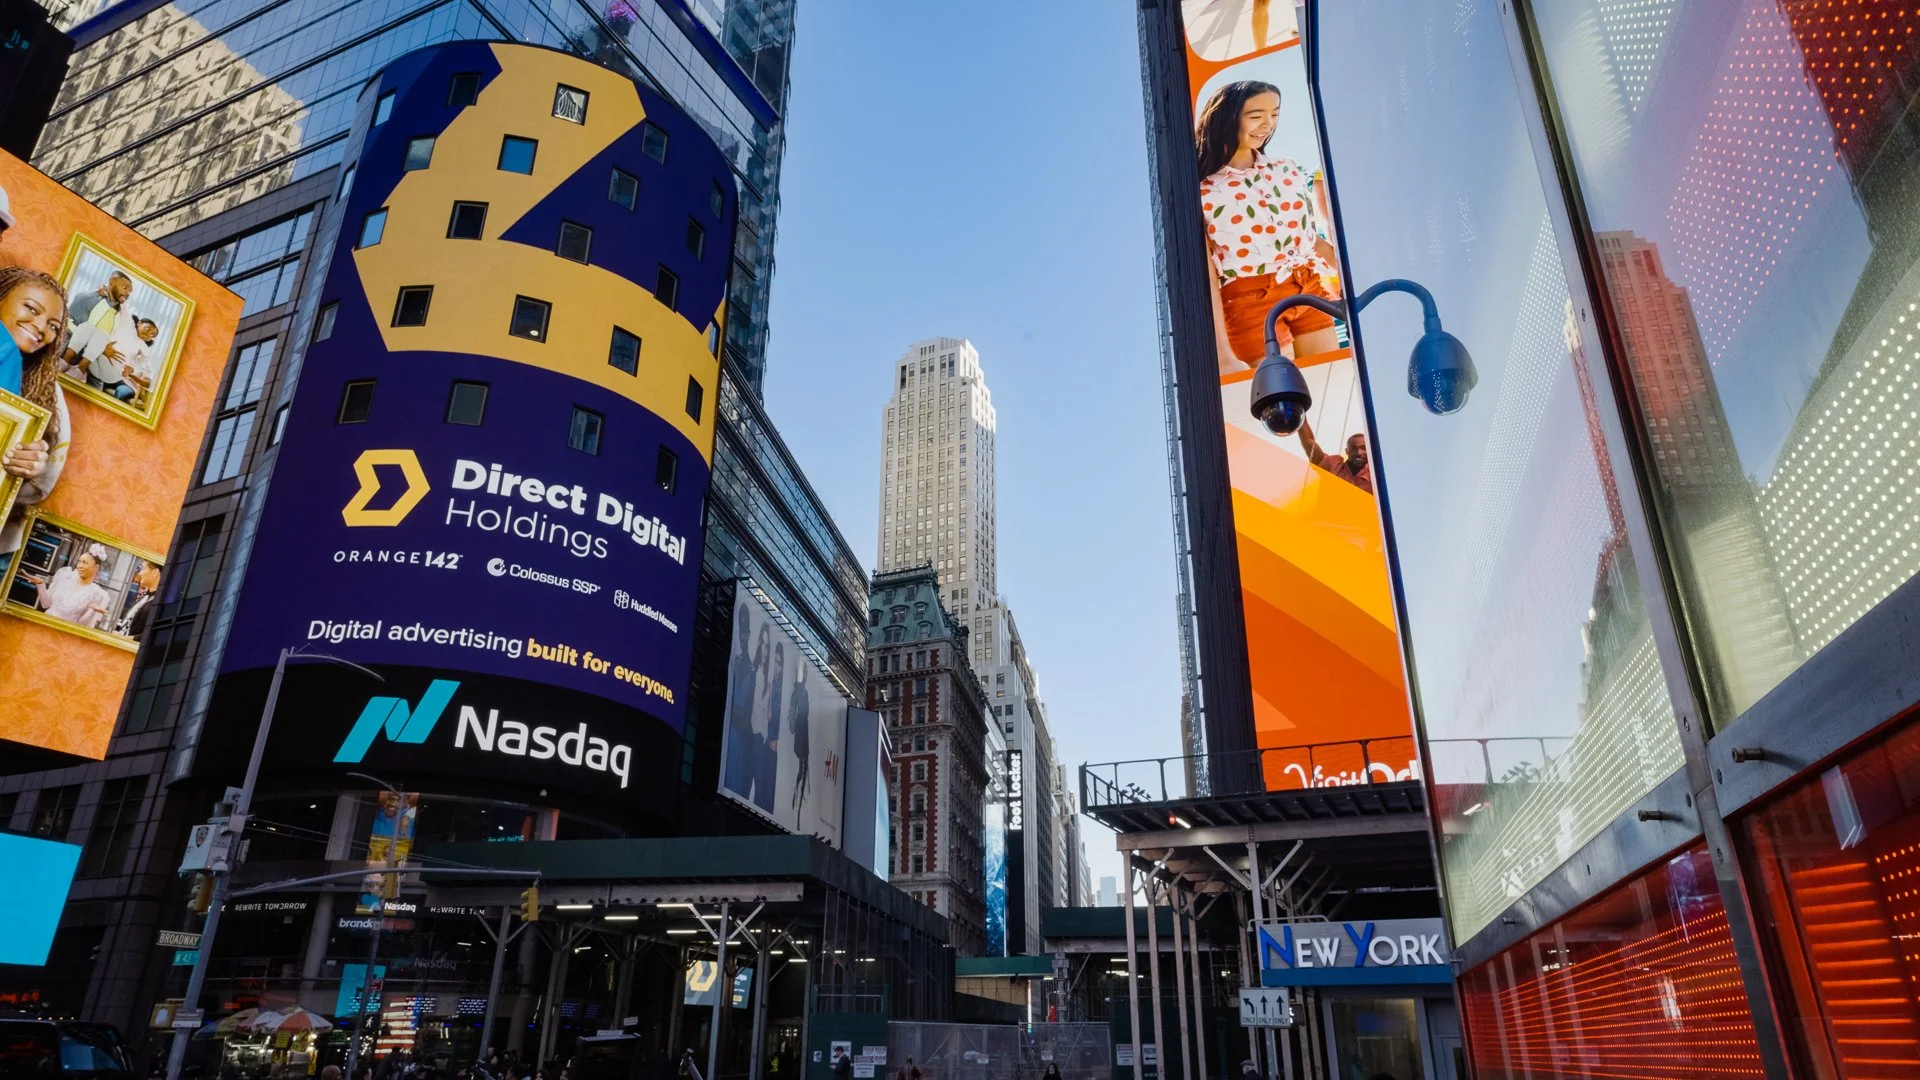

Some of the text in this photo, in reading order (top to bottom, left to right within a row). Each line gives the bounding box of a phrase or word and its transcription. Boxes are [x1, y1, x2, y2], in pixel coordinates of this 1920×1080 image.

[445, 498, 609, 559] Holdings
[451, 459, 687, 566] Direct Digital
[509, 564, 570, 589] Colossus
[630, 598, 679, 634] Huddled Masses
[307, 620, 675, 705] Digital advertising built for everyone.
[454, 705, 633, 789] Nasdaq
[1008, 752, 1022, 830] Foot Locker
[234, 904, 262, 912] REWRITE
[264, 902, 307, 911] TOMORROW
[384, 902, 417, 913] Nasdaq
[159, 932, 200, 947] BROADWAY
[1259, 922, 1445, 970] NEW YORK
[1242, 1017, 1288, 1025] ONLY ONLY ONLY
